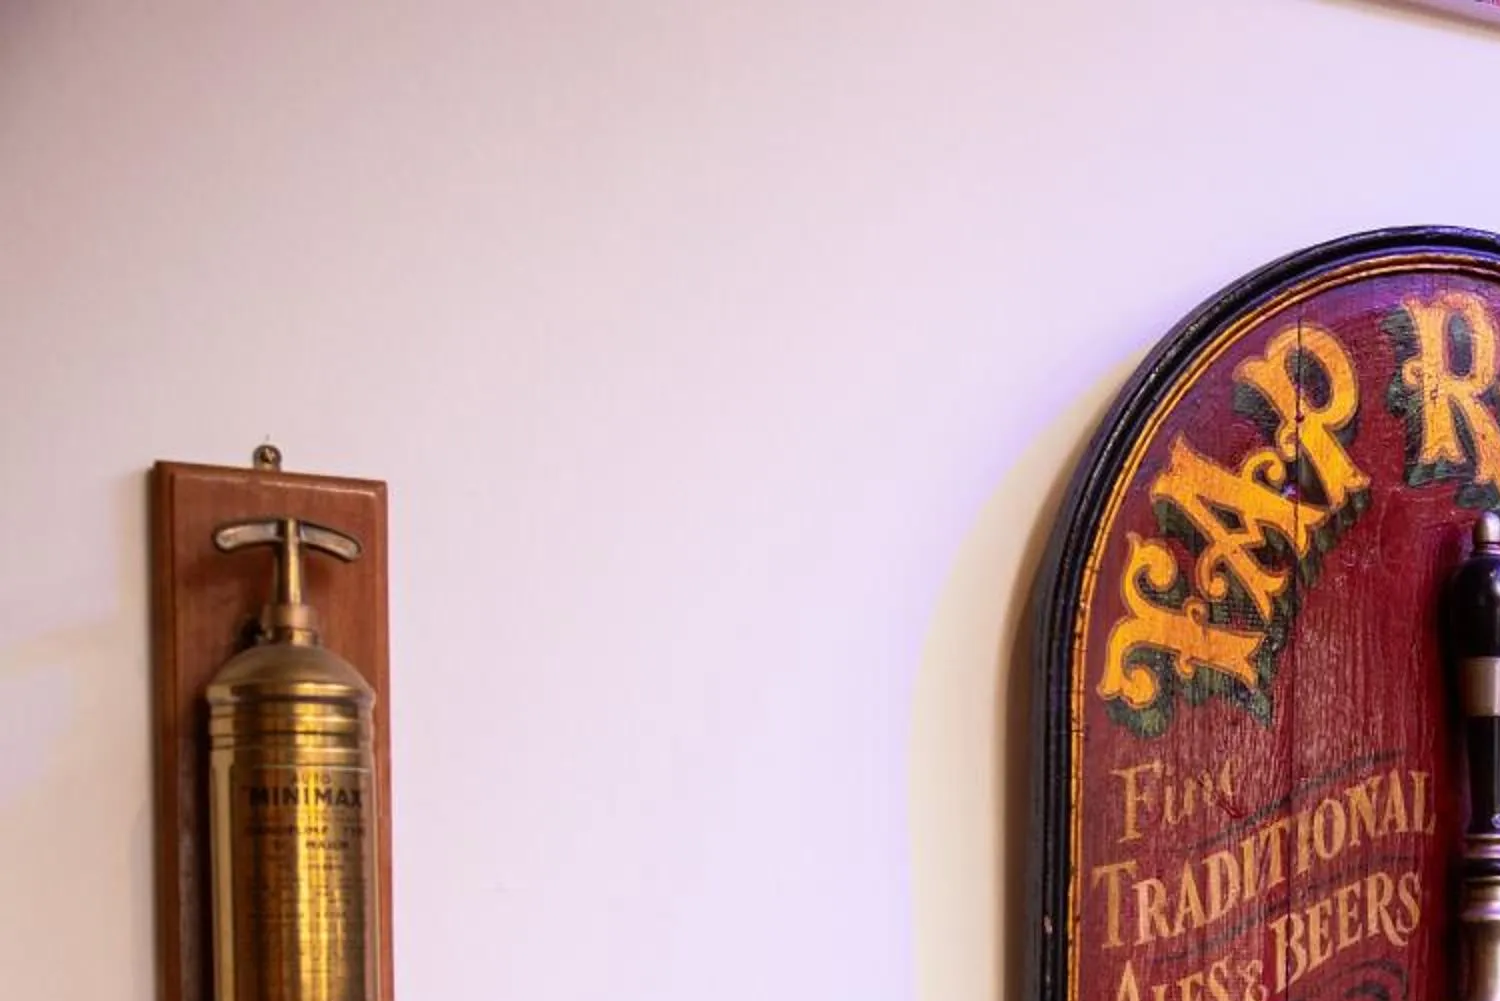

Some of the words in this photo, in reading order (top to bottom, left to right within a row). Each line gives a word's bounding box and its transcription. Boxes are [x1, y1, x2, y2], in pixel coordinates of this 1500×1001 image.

[1097, 323, 1371, 710] TAP
[1091, 768, 1436, 949] TRADITIONAL
[1269, 870, 1423, 995] BEERS
